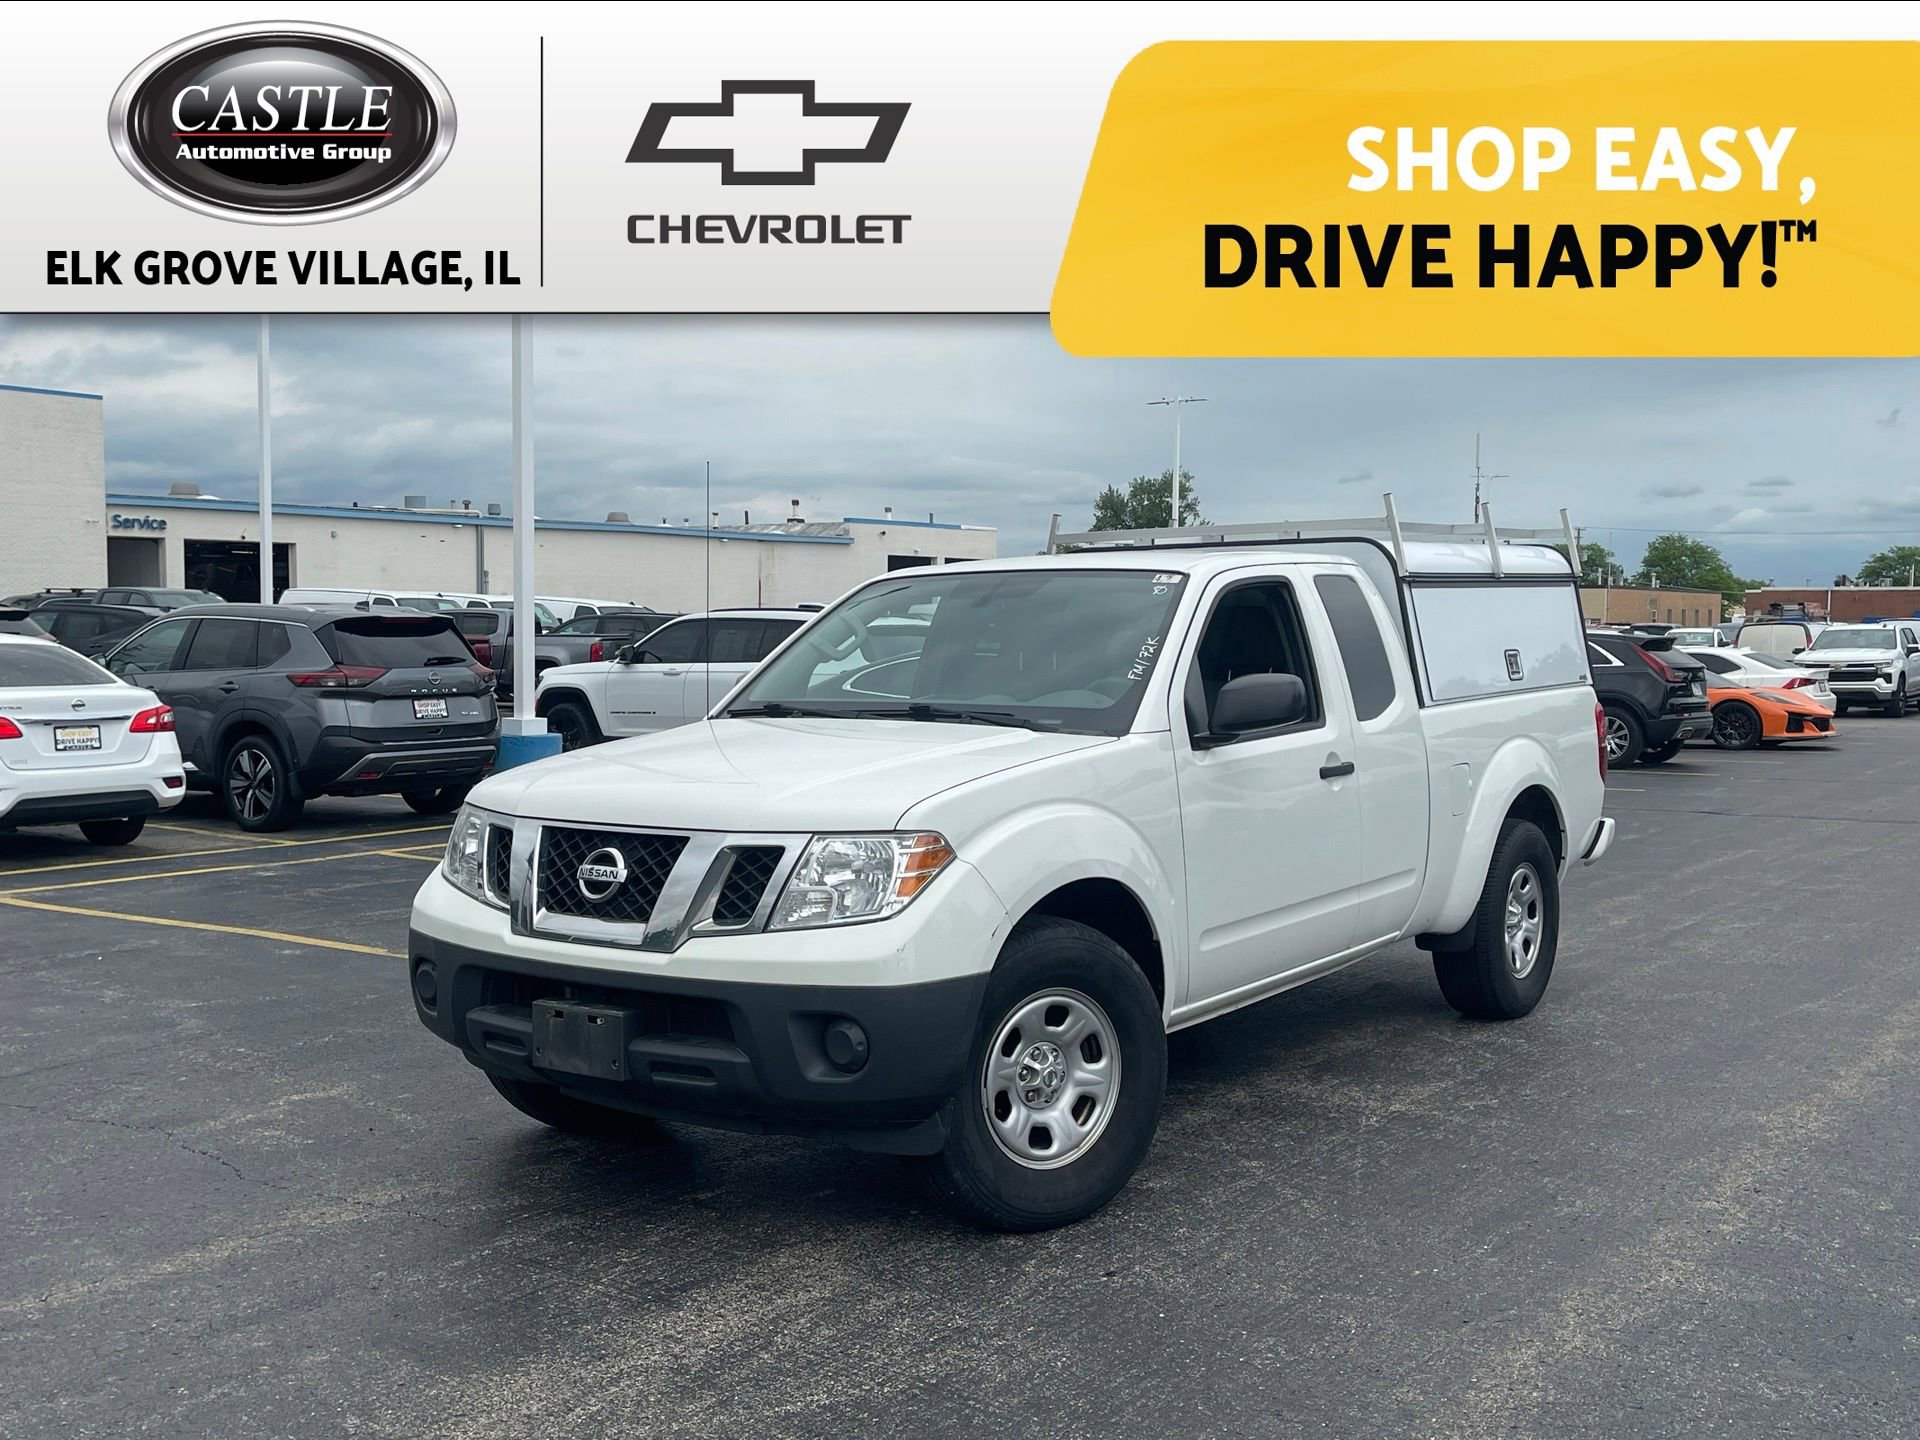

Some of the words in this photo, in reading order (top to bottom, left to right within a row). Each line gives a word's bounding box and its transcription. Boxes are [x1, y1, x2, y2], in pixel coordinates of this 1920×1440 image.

[111, 513, 168, 530] Service
[56, 737, 75, 745] DRIVE
[579, 867, 619, 879] NISSAN
